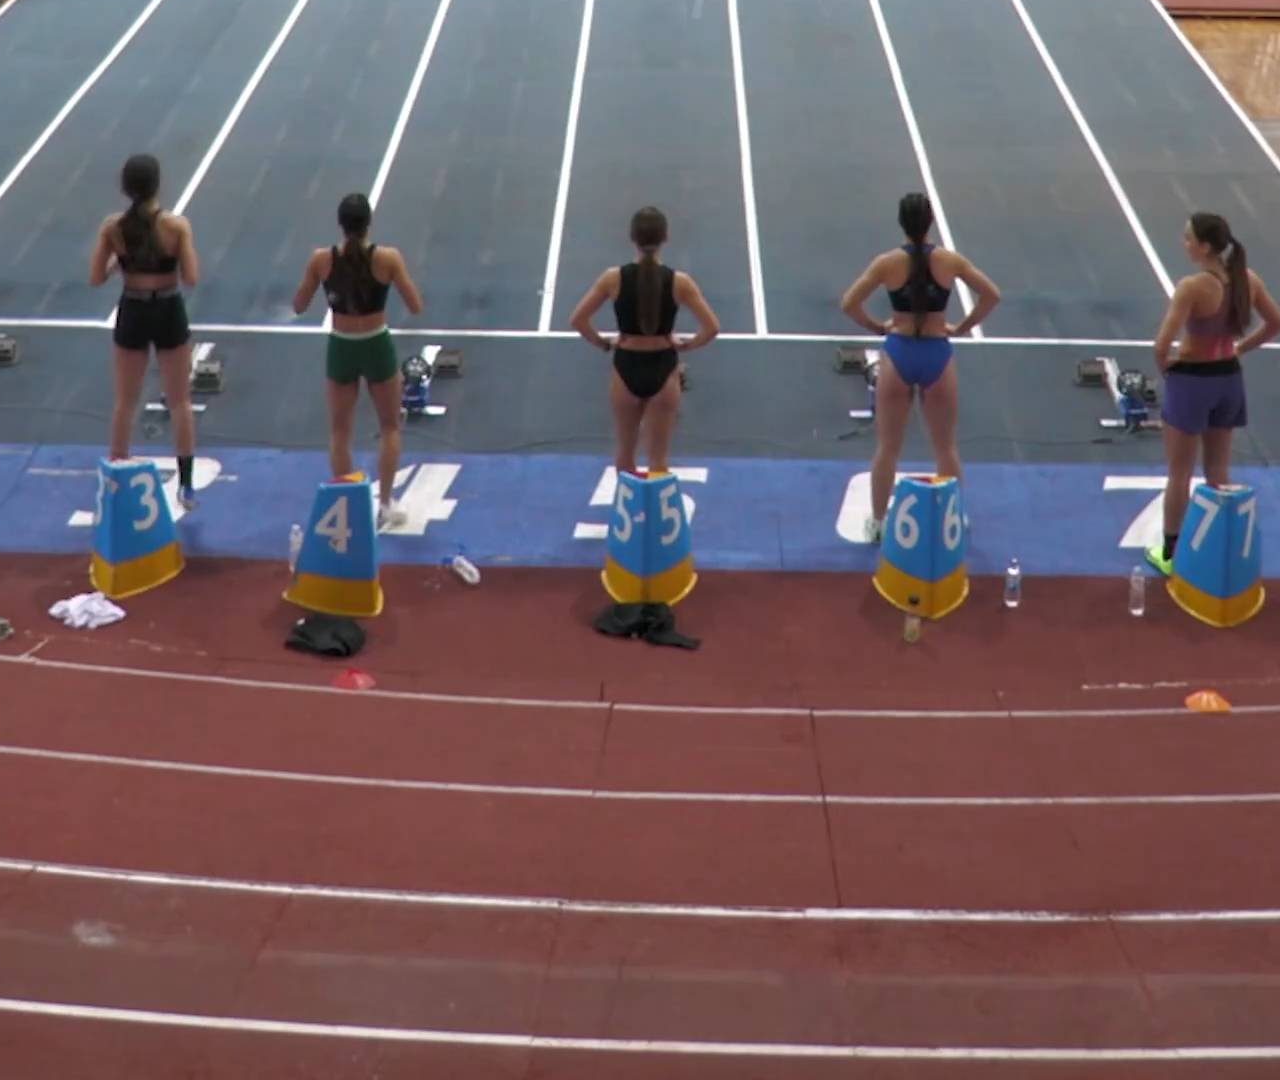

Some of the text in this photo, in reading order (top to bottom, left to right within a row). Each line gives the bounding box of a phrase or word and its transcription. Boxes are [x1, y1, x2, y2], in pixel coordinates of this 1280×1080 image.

[129, 472, 160, 531] 3
[313, 495, 353, 553] 4
[613, 483, 634, 543] 5
[658, 483, 683, 546] 5
[893, 493, 920, 550] 6
[943, 491, 963, 551] 6
[1189, 494, 1220, 552] 7
[1236, 497, 1257, 559] 7
